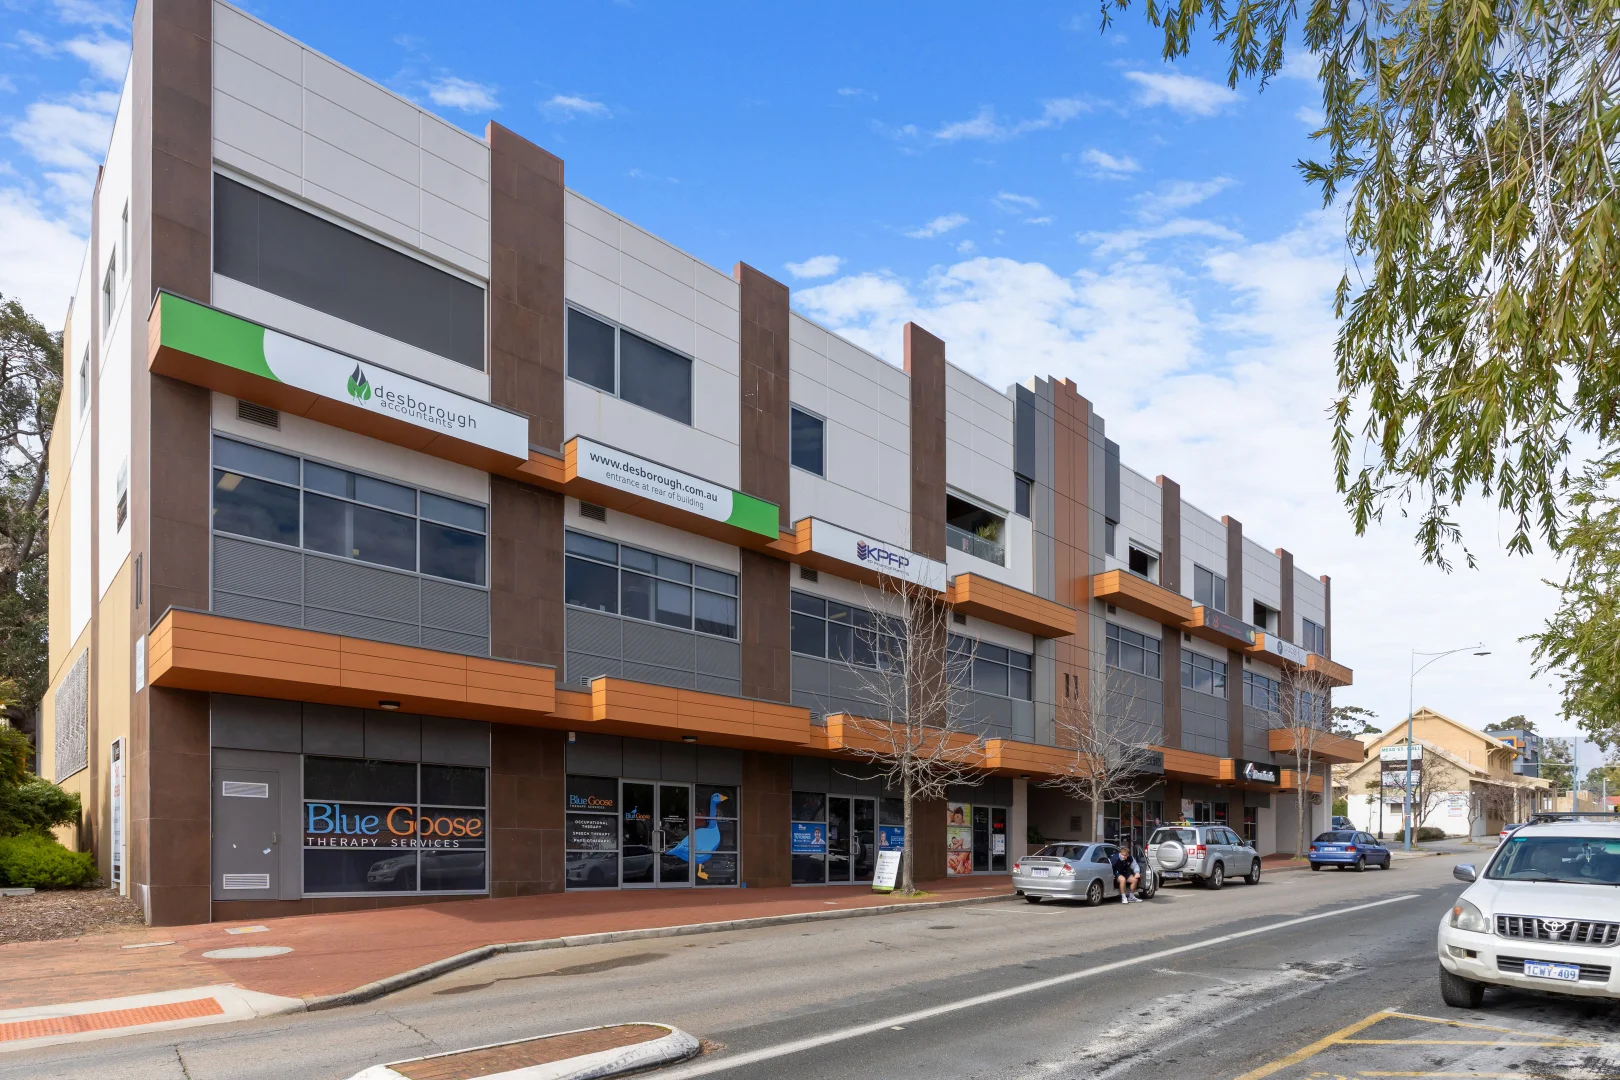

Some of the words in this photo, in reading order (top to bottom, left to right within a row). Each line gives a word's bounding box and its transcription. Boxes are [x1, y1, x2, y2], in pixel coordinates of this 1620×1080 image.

[374, 386, 477, 429] desborough
[381, 399, 453, 429] accountants
[590, 452, 718, 502] www.desborough.com.au
[605, 471, 640, 489] entrance
[641, 482, 650, 492] at
[651, 486, 667, 497] rear
[667, 491, 676, 500] of
[676, 494, 704, 511] building
[867, 545, 910, 568] KPFP
[570, 794, 588, 805] Blue
[588, 796, 614, 806] Goose
[306, 803, 380, 835] Blue
[387, 806, 482, 837] Goose
[307, 837, 378, 847] THERAPY
[391, 838, 460, 848] SERVICES
[1527, 966, 1576, 979] 1CWY-409
